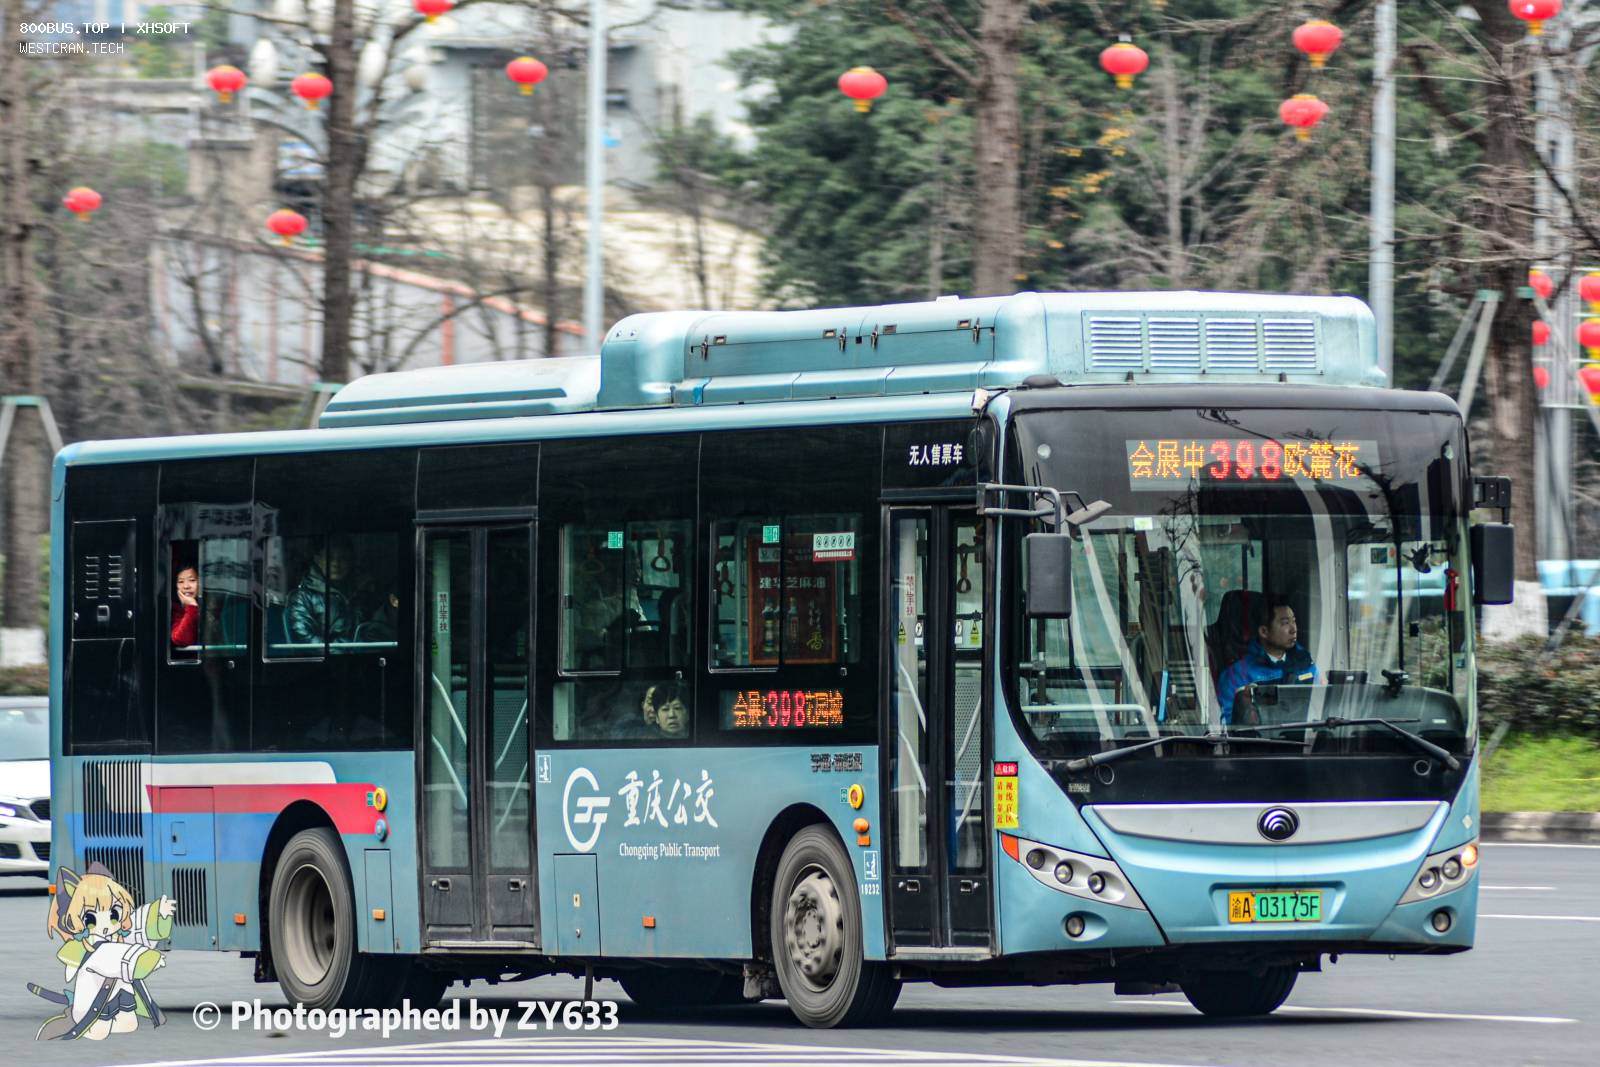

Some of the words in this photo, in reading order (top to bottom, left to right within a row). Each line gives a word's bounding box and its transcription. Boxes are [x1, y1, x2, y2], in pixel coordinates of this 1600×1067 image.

[909, 443, 963, 466] 无人售票车
[618, 769, 719, 828] 重庆公交
[619, 842, 659, 860] Chongqing
[659, 842, 682, 857] Public
[683, 842, 721, 861] Transport
